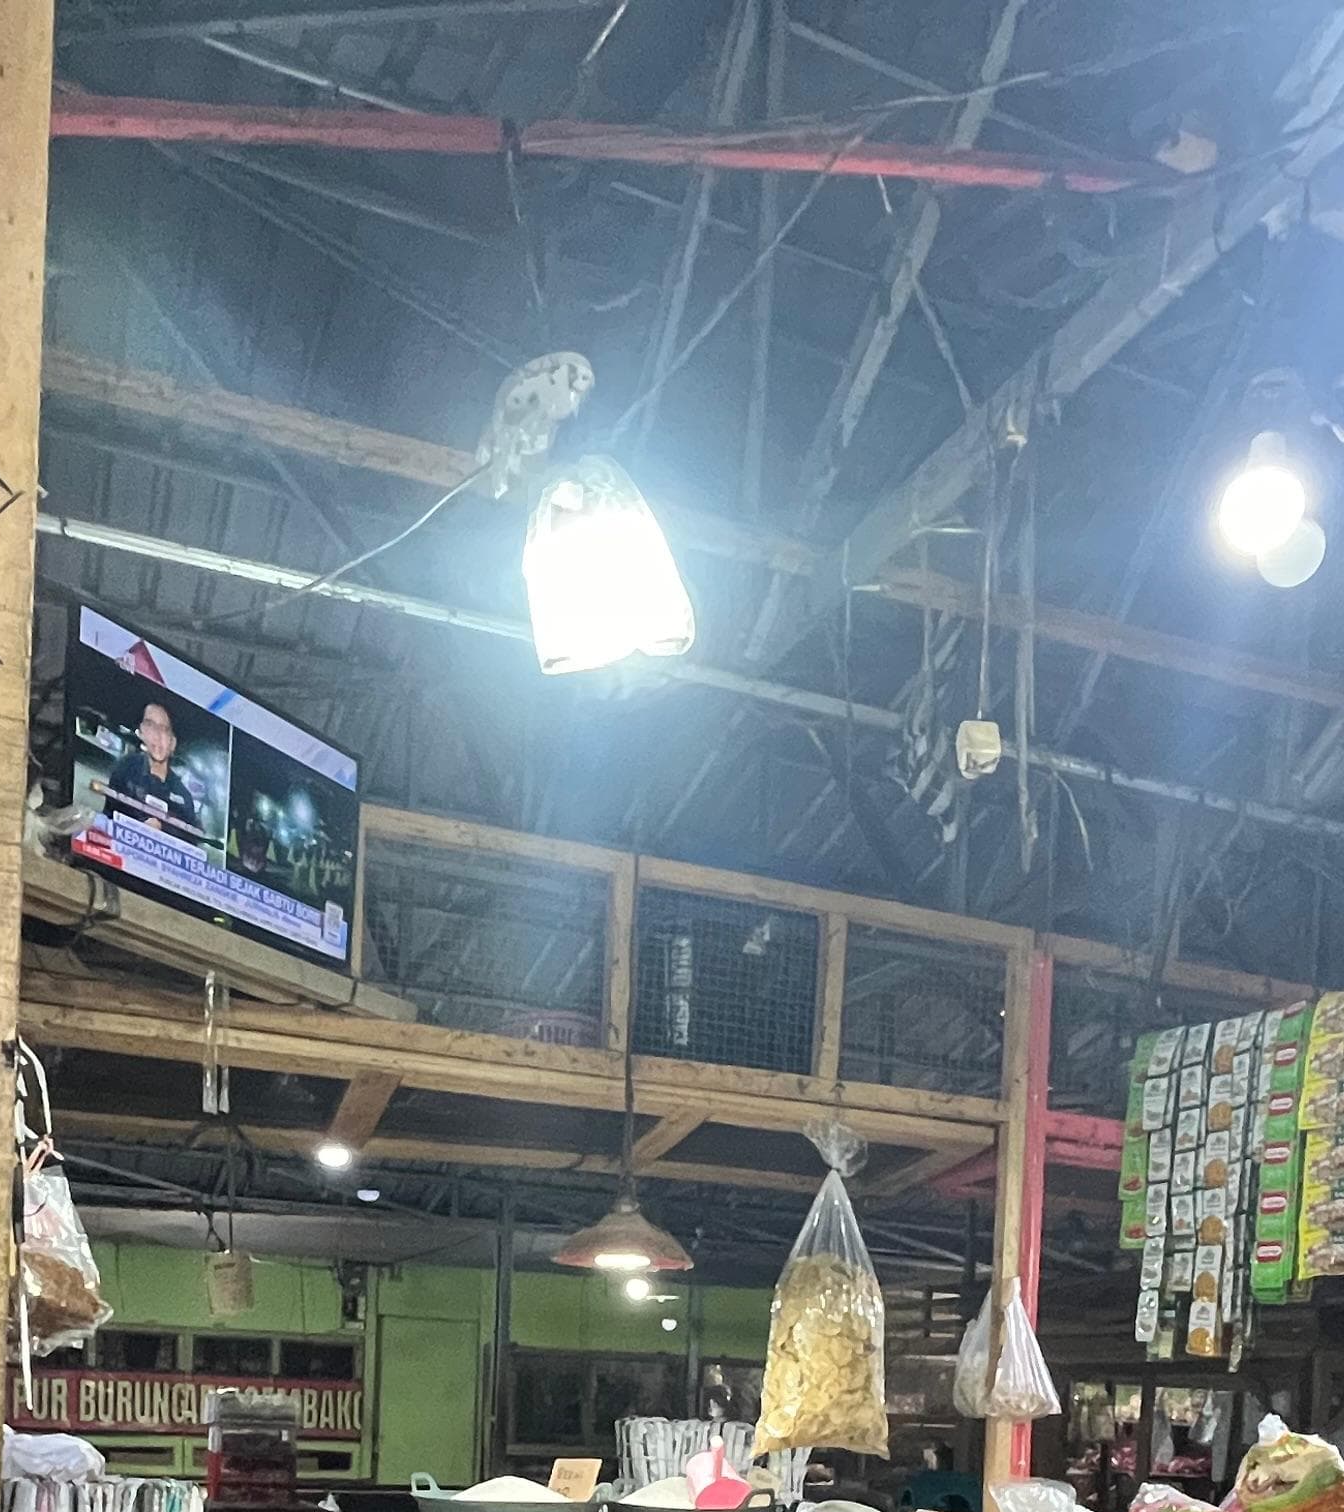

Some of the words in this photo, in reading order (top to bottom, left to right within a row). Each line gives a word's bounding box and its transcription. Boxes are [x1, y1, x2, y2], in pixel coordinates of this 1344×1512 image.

[115, 824, 184, 866] KEPADATAN
[184, 854, 228, 886] TERJADI
[230, 875, 261, 900] SEJAK
[263, 889, 295, 915] SABTU
